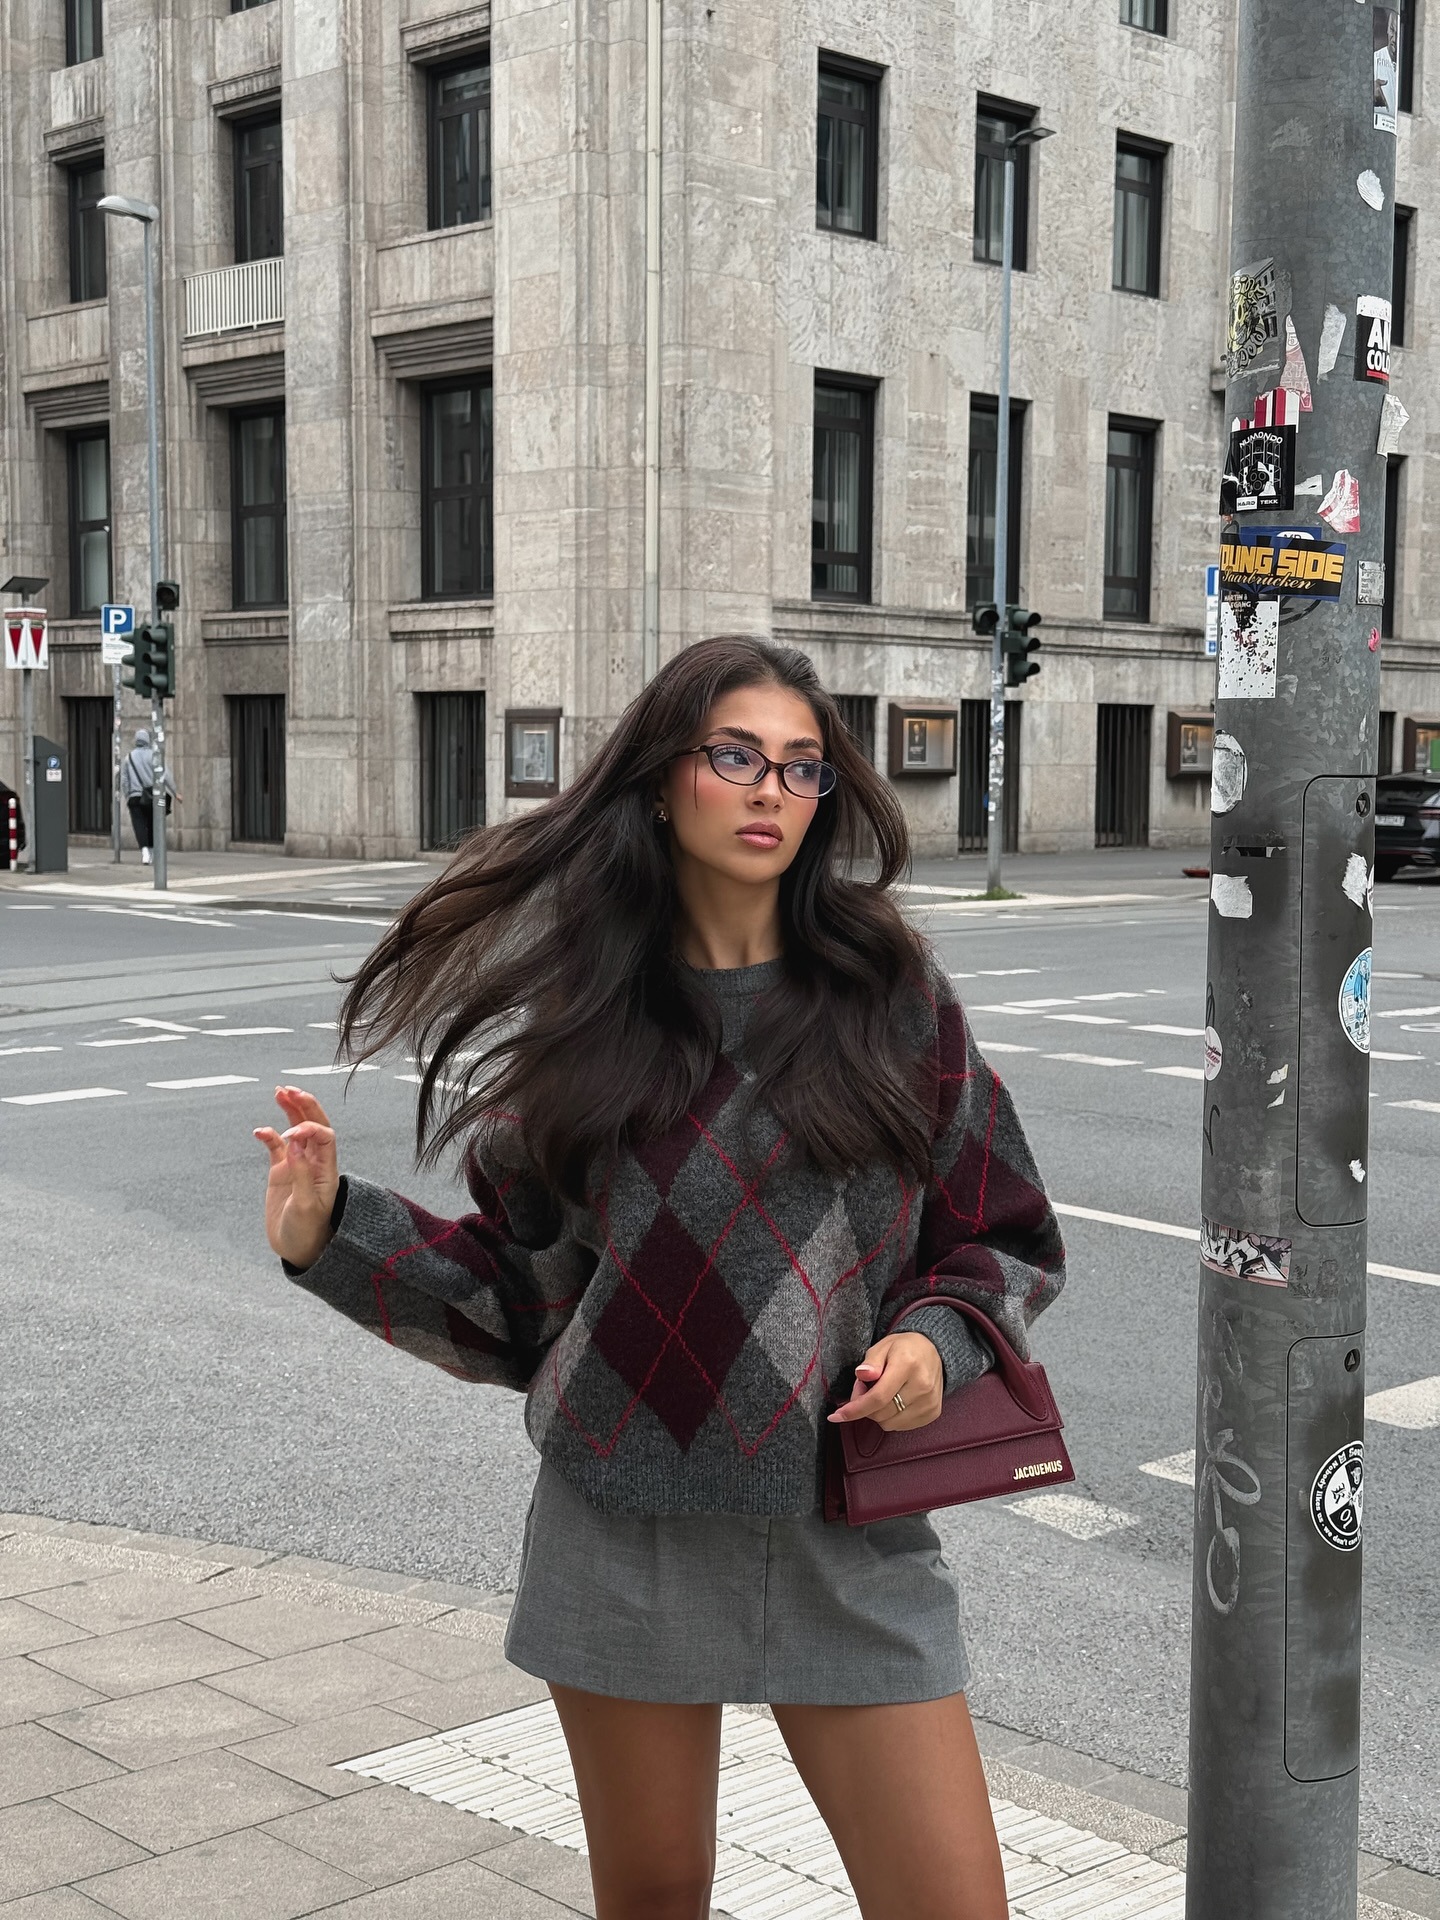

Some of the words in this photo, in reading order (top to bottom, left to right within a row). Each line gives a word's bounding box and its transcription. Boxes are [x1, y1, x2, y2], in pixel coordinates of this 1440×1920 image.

[1239, 431, 1283, 449] NUMONDO
[1220, 544, 1275, 575] OUNG
[1276, 548, 1345, 583] SIDE
[1222, 566, 1317, 590] Saarbrücken
[109, 609, 127, 633] P
[1013, 1459, 1063, 1480] JACQUEMUS
[1318, 1460, 1338, 1489] Nobody
[1315, 1490, 1323, 1511] likes
[1323, 1526, 1332, 1537] we
[1333, 1535, 1348, 1546] don't
